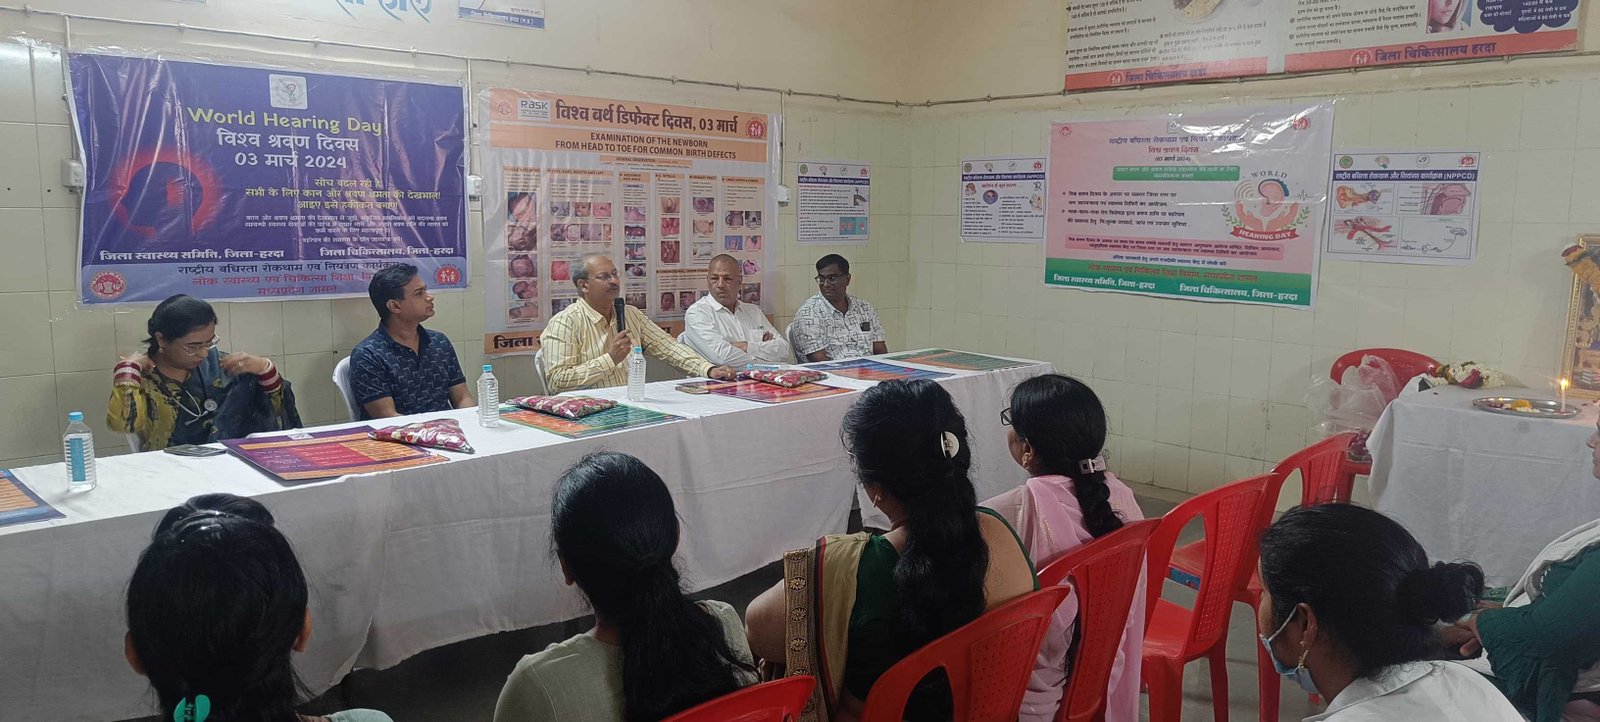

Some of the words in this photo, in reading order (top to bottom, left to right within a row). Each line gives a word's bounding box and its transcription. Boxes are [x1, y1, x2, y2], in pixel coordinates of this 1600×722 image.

[1375, 49, 1400, 61] जिला
[1404, 46, 1468, 60] चिकित्सालय
[1471, 42, 1496, 55] हरदा
[187, 106, 256, 126] World
[263, 112, 341, 133] Hearing
[347, 118, 382, 136] Day
[556, 98, 589, 121] विश्व
[592, 104, 614, 123] बर्थ
[616, 104, 660, 127] डिफेक्ट
[662, 109, 696, 131] दिवस,
[699, 118, 714, 131] 03
[716, 116, 738, 133] मार्च
[216, 128, 261, 147] विश्व
[268, 133, 310, 149] श्रवण
[317, 133, 359, 151] दिवस
[590, 132, 645, 144] EXAMINATION
[645, 136, 656, 145] OF
[657, 137, 672, 146] THE
[672, 138, 708, 148] NEWBORN
[555, 140, 580, 150] FROM
[581, 141, 603, 151] HEAD
[605, 143, 616, 152] TO
[617, 144, 632, 153] TOE
[633, 145, 648, 154] FOR
[649, 146, 683, 156] COMMON
[686, 148, 706, 158] BIRTH
[707, 150, 736, 159] DEFECTS
[234, 152, 258, 166] 03
[264, 151, 298, 168] मार्च
[304, 155, 347, 169] 2024
[1251, 170, 1288, 179] WORLD
[1443, 171, 1475, 180] (NPPCD)
[314, 178, 333, 188] सोच
[245, 187, 264, 197] सभी
[268, 187, 278, 197] के
[282, 187, 299, 198] लिए
[302, 189, 322, 198] कान
[297, 200, 321, 209] आइए
[325, 199, 338, 209] इसे
[1239, 229, 1274, 240] HEARING
[1275, 231, 1291, 239] DAY
[100, 250, 132, 261] जिला
[135, 250, 176, 260] स्वास्थ्य
[181, 249, 222, 260] समिति,
[225, 248, 284, 259] जिला-हरदा
[320, 247, 345, 257] जिला
[347, 247, 405, 258] चिकित्सालय,
[407, 246, 454, 255] जिला-हरदा
[178, 264, 214, 275] राष्ट्रीय
[219, 263, 257, 274] बधिरता
[262, 262, 302, 273] रोकथाम
[307, 261, 321, 271] एवं
[325, 261, 358, 271] नियंत्रण
[192, 275, 218, 286] लोक
[284, 273, 327, 283] चिकित्सा
[1054, 273, 1069, 282] जिला
[1071, 276, 1093, 284] स्वास्थ्य
[1180, 283, 1199, 293] जिला
[1252, 288, 1298, 301] जिला-हरदा
[493, 335, 533, 349] जिला
